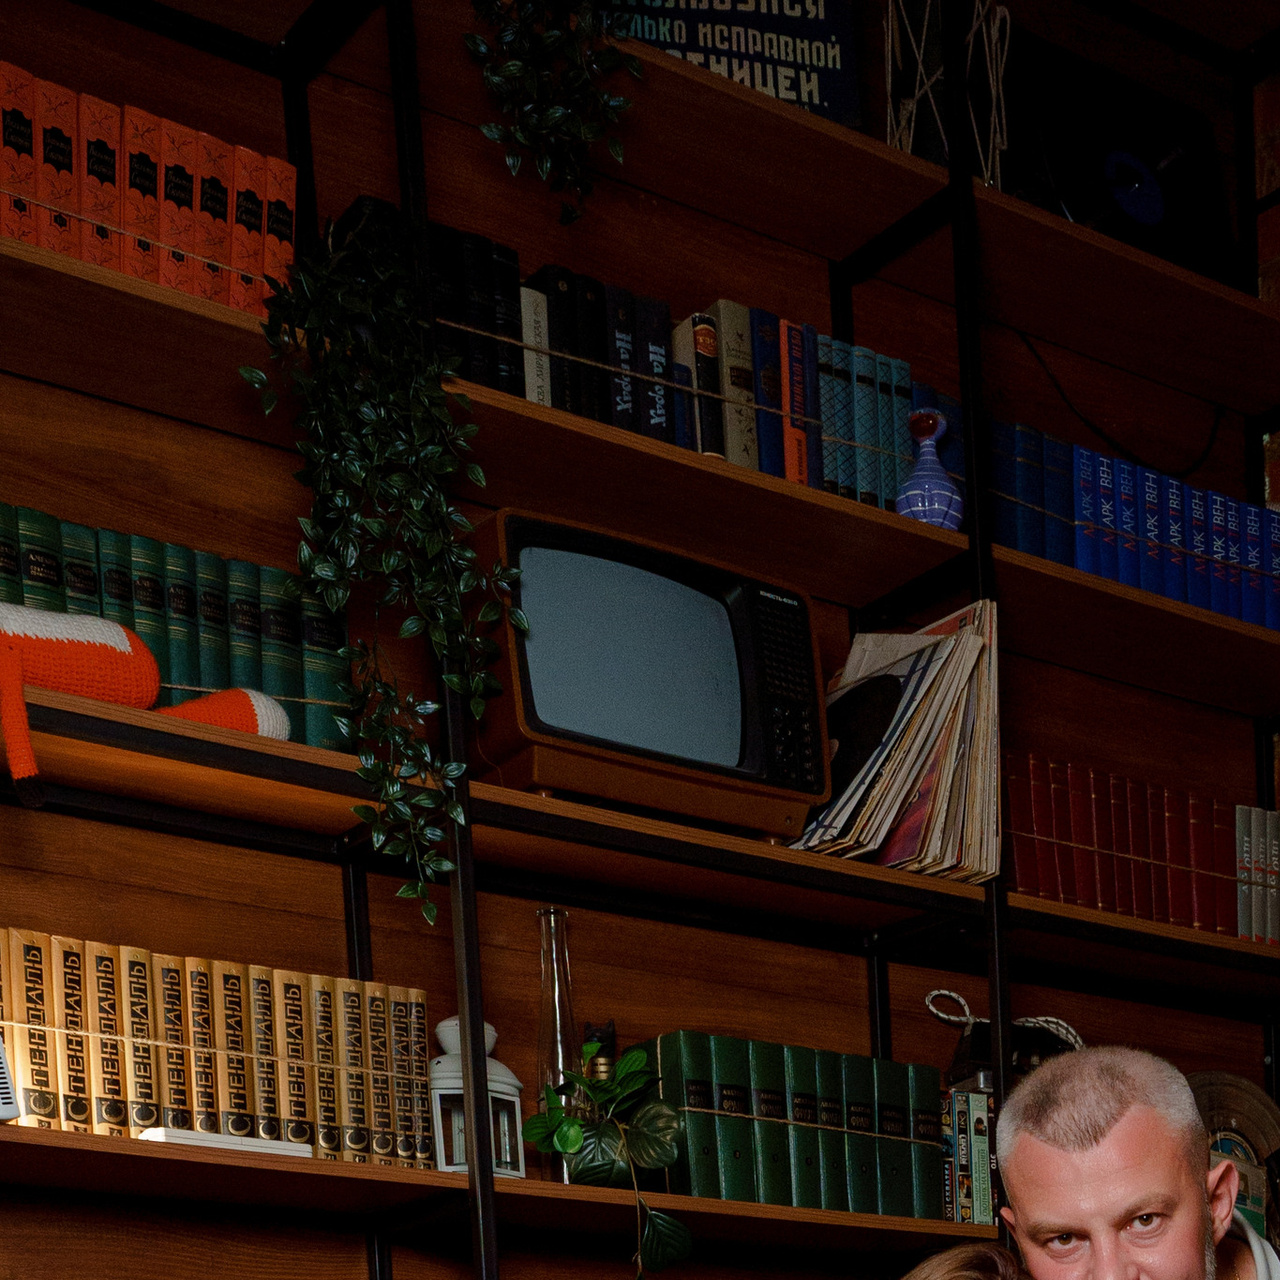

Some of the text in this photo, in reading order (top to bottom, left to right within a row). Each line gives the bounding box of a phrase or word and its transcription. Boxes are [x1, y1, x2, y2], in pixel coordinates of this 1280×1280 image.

[697, 21, 842, 70] ИСПРАВНОЙ
[615, 329, 633, 360] На
[648, 342, 666, 374] На
[1080, 449, 1093, 488] ТВЕН
[1099, 457, 1113, 495] ТВЕН
[1120, 464, 1133, 501] ТВЕН
[1145, 472, 1158, 510] ТВЕН
[1168, 479, 1181, 516] ТВЕН
[1191, 490, 1204, 527] ТВЕН
[1212, 495, 1225, 533] ТВЕН
[1227, 501, 1240, 538] ТВЕН
[1246, 506, 1260, 543] ТВЕН
[25, 946, 57, 1116] СТЕНДАЛЬ
[65, 952, 90, 1122] СТЕНДАЛЬ
[97, 957, 127, 1124] СТЕНДАЛЬ
[130, 962, 158, 1127] СТЕНДАЛЬ
[163, 970, 191, 1129] СТЕНДАЛЬ
[192, 973, 217, 1133] СТЕНДАЛЬ
[224, 976, 252, 1136] СТЕНДАЛЬ
[254, 980, 279, 1141] СТЕНДАЛЬ
[285, 985, 312, 1143] СТЕНДАЛЬ
[316, 992, 340, 1149] СТЕНДАЛЬ
[345, 993, 369, 1151] СТЕНДАЛЬ
[370, 998, 393, 1154] СТЕНДАЛЬ
[393, 1003, 415, 1157] СТЕНДАЛЬ
[410, 1004, 433, 1159] СТЕНДАЛЬ
[943, 1163, 952, 1202] СХВАТКА
[989, 1153, 997, 1170] ЭТО
